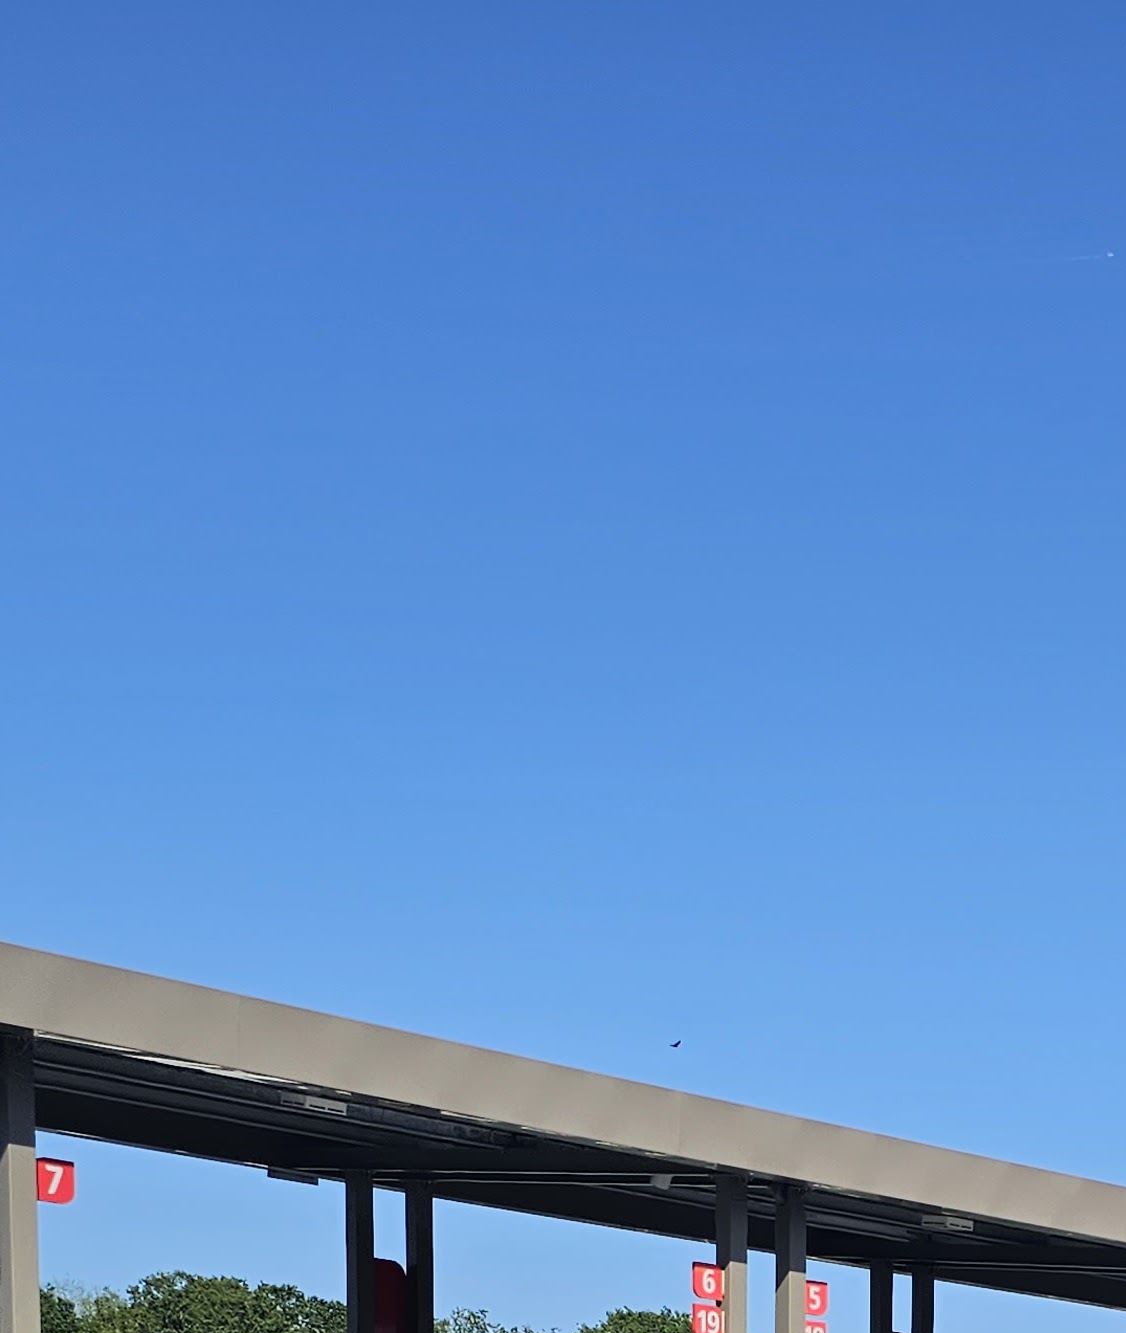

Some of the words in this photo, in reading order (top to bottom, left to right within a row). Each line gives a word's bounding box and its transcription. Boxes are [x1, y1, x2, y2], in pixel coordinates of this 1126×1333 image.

[45, 1163, 64, 1195] 7
[702, 1269, 716, 1294] 6
[808, 1285, 821, 1311] 5
